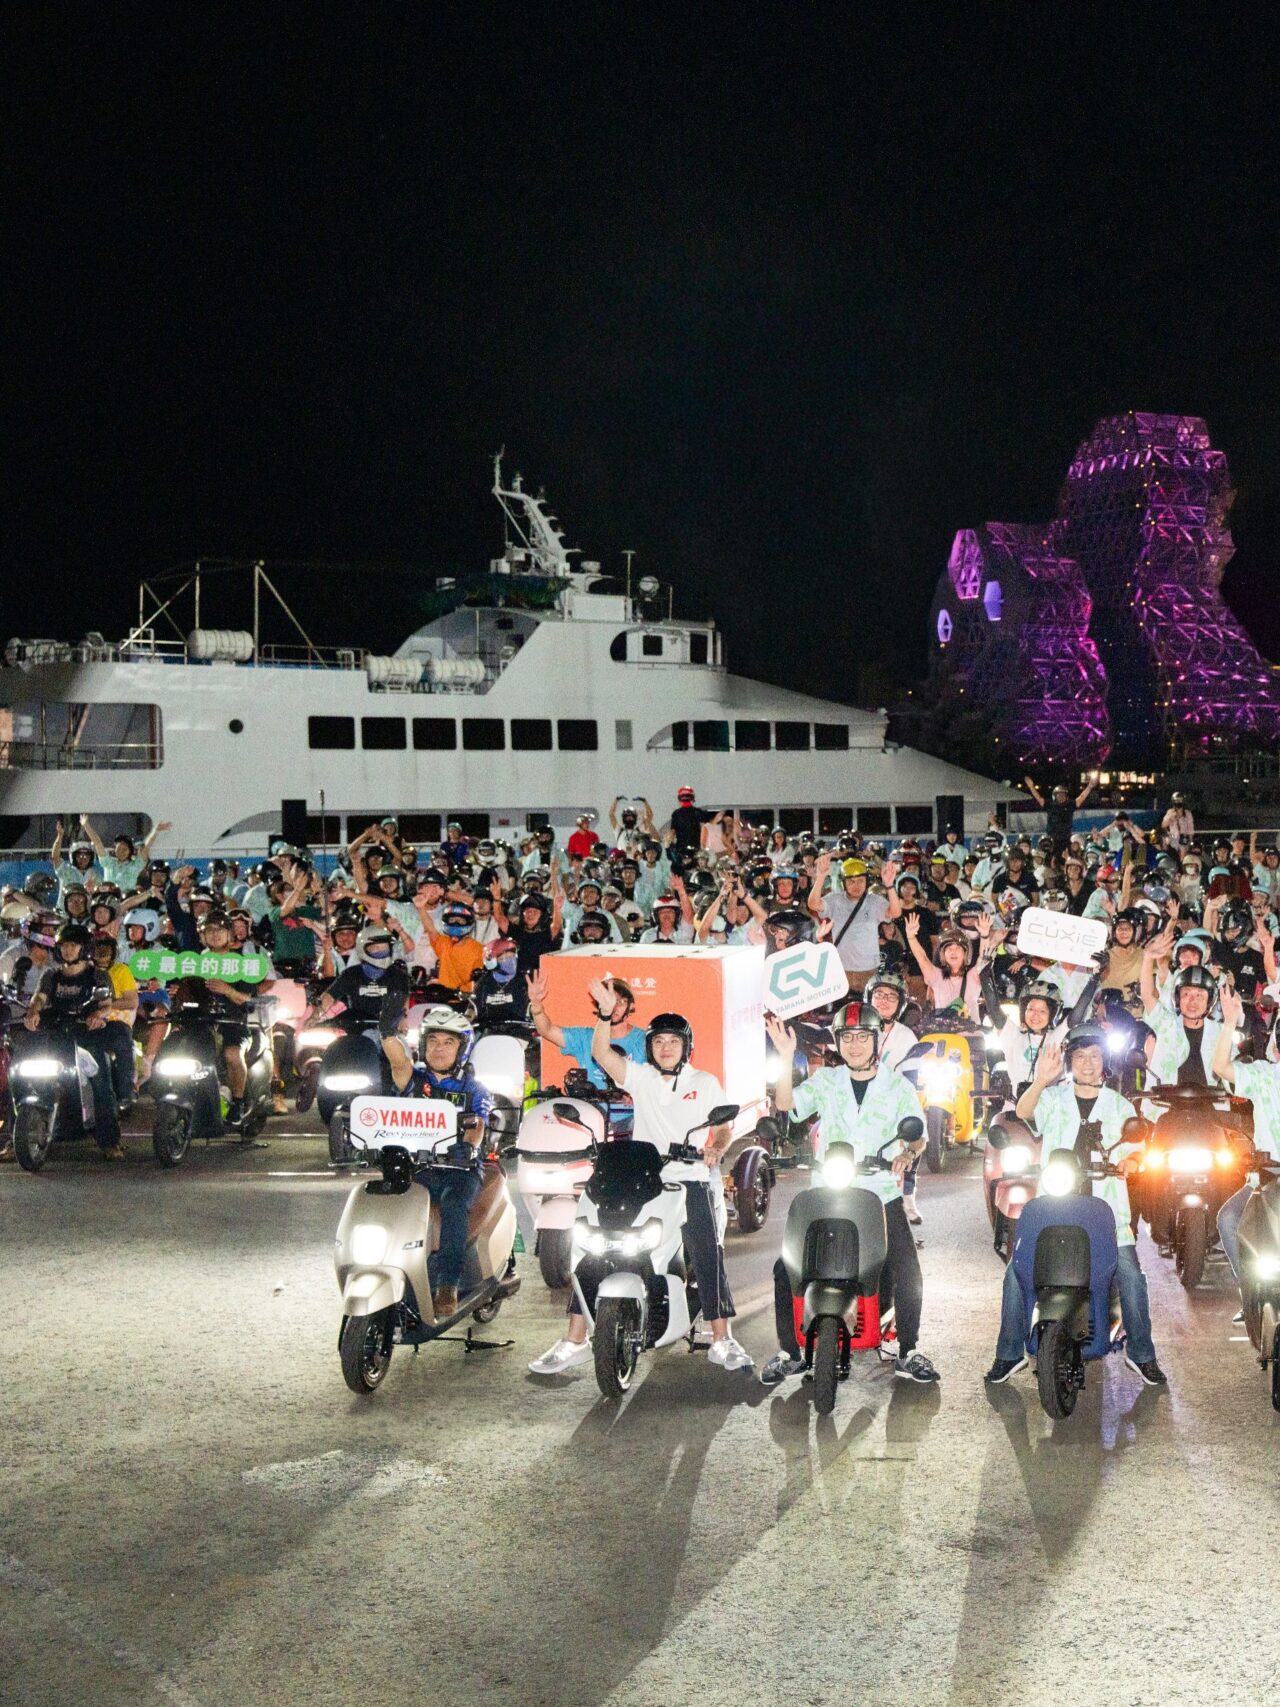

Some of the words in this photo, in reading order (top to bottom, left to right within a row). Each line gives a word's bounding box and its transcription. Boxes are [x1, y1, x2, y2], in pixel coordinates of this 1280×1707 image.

[775, 998, 805, 1014] YAMAHA
[807, 987, 832, 1002] MOTOR
[380, 1109, 447, 1129] YAMAHA
